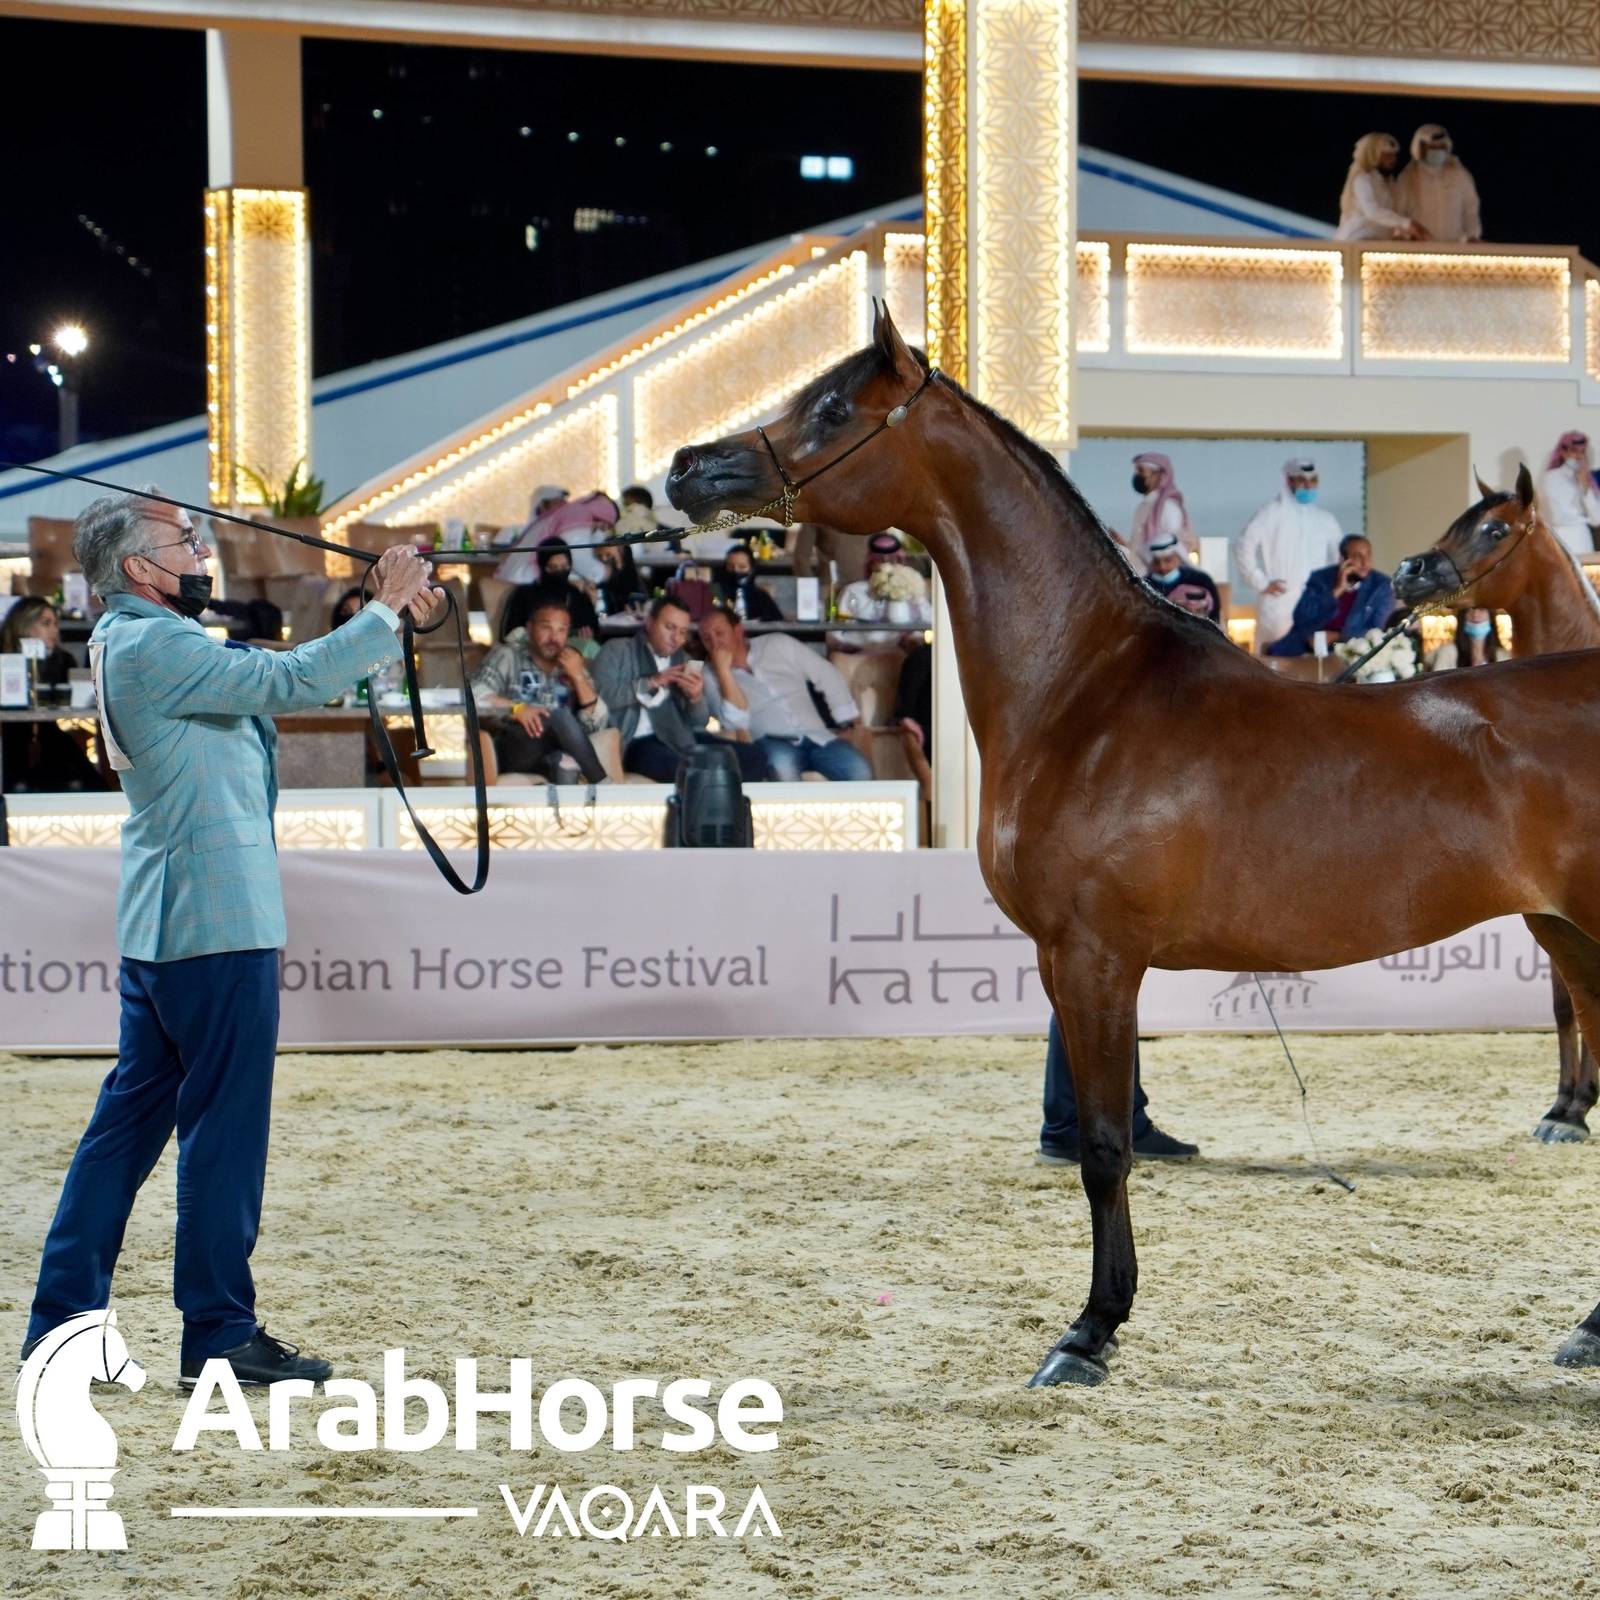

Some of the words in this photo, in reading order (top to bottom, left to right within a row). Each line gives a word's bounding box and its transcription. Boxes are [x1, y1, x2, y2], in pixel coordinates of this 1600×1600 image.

[830, 893, 1035, 941] تارا
[0, 949, 121, 993] tion
[409, 947, 564, 991] Horse
[581, 944, 769, 988] Festival
